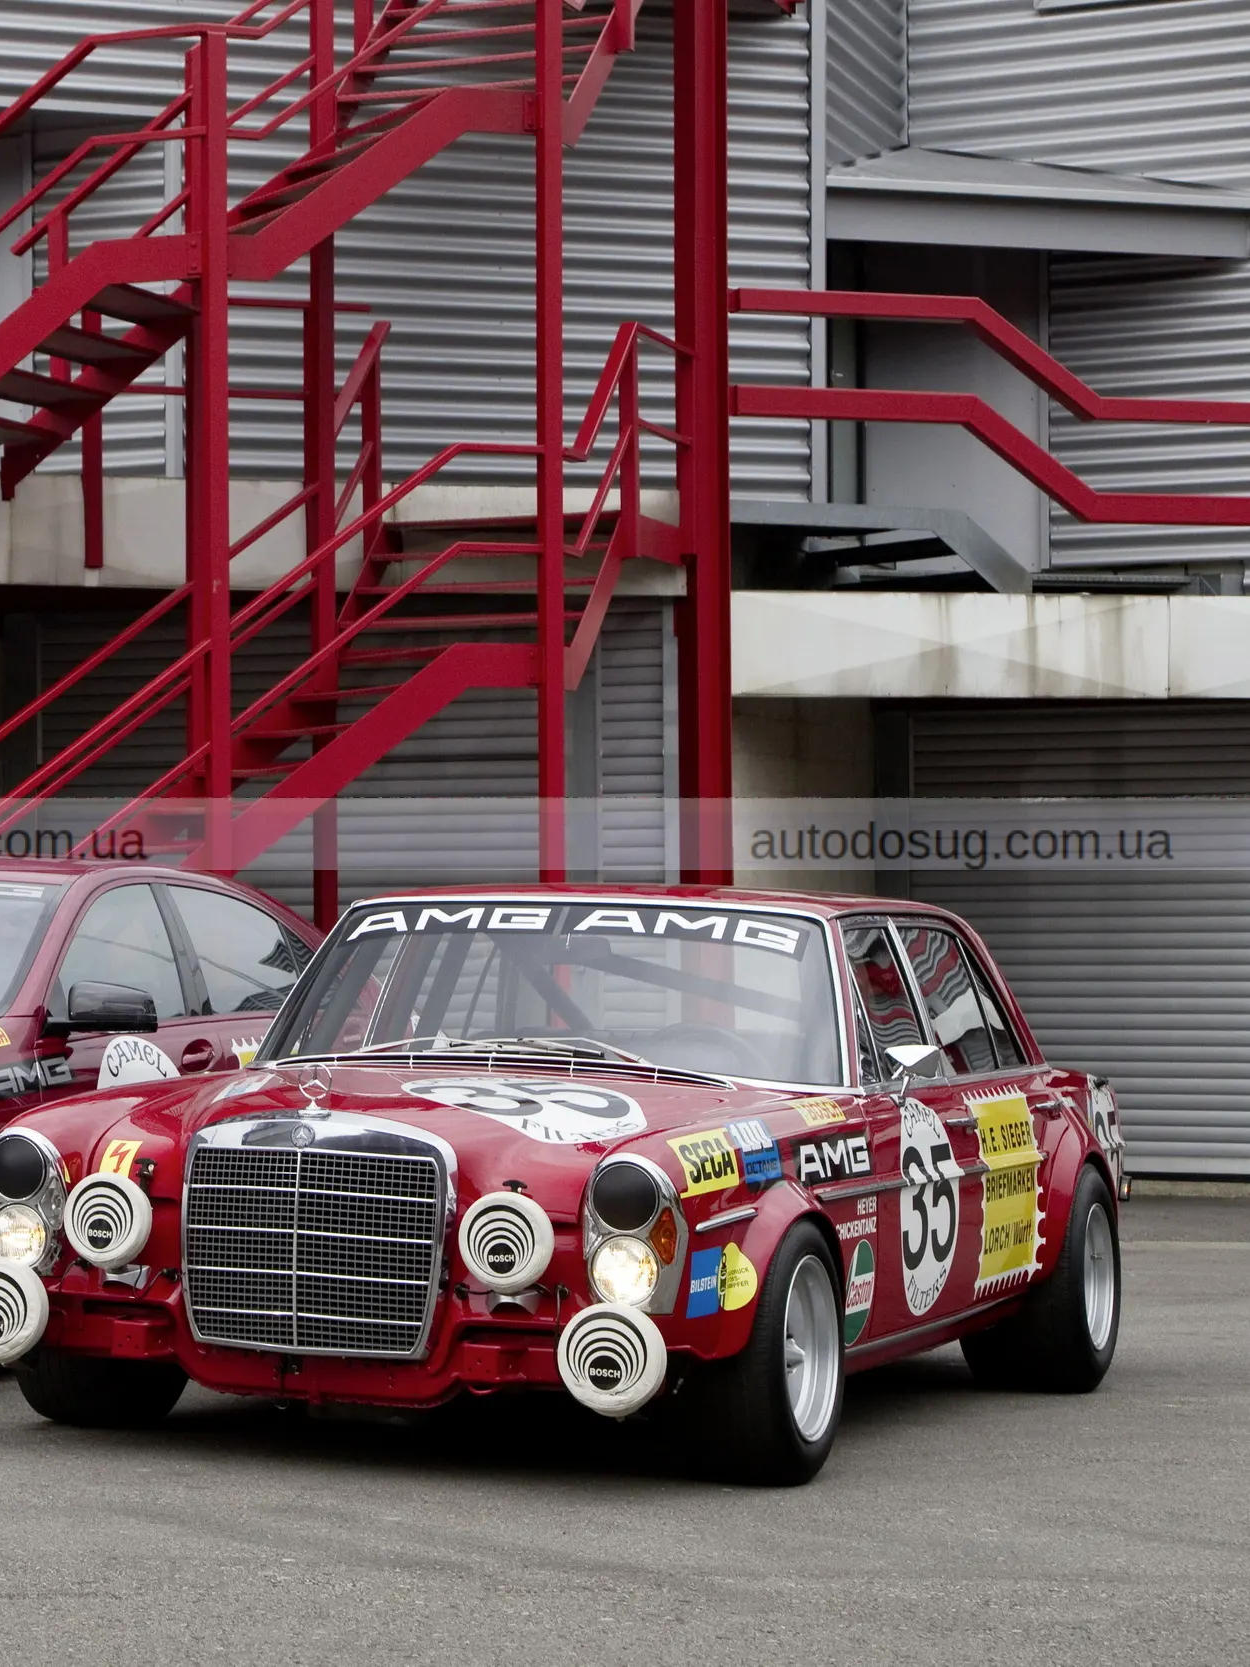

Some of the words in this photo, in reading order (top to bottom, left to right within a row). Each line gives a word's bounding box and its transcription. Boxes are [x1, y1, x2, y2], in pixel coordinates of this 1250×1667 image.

[347, 907, 551, 941] AMG
[573, 910, 800, 955] AMG
[106, 1040, 168, 1078] CAMEL
[410, 1082, 630, 1118] 35
[804, 1101, 843, 1121] BOSCH
[729, 1120, 774, 1152] 100
[904, 1103, 941, 1138] CAMEL
[980, 1127, 1000, 1154] H.E.
[1000, 1121, 1032, 1150] SIEGER
[679, 1137, 735, 1184] SECA
[800, 1137, 870, 1182] AMG
[986, 1167, 1035, 1202] BRIEFMARKEN
[857, 1196, 877, 1215] HEYER
[902, 1143, 956, 1270] 35
[88, 1229, 112, 1239] BOSCH
[488, 1254, 515, 1263] BOSCH
[690, 1275, 717, 1293] BILSTEIN
[907, 1265, 947, 1310] FILTERS
[589, 1367, 620, 1378] BOSCH
